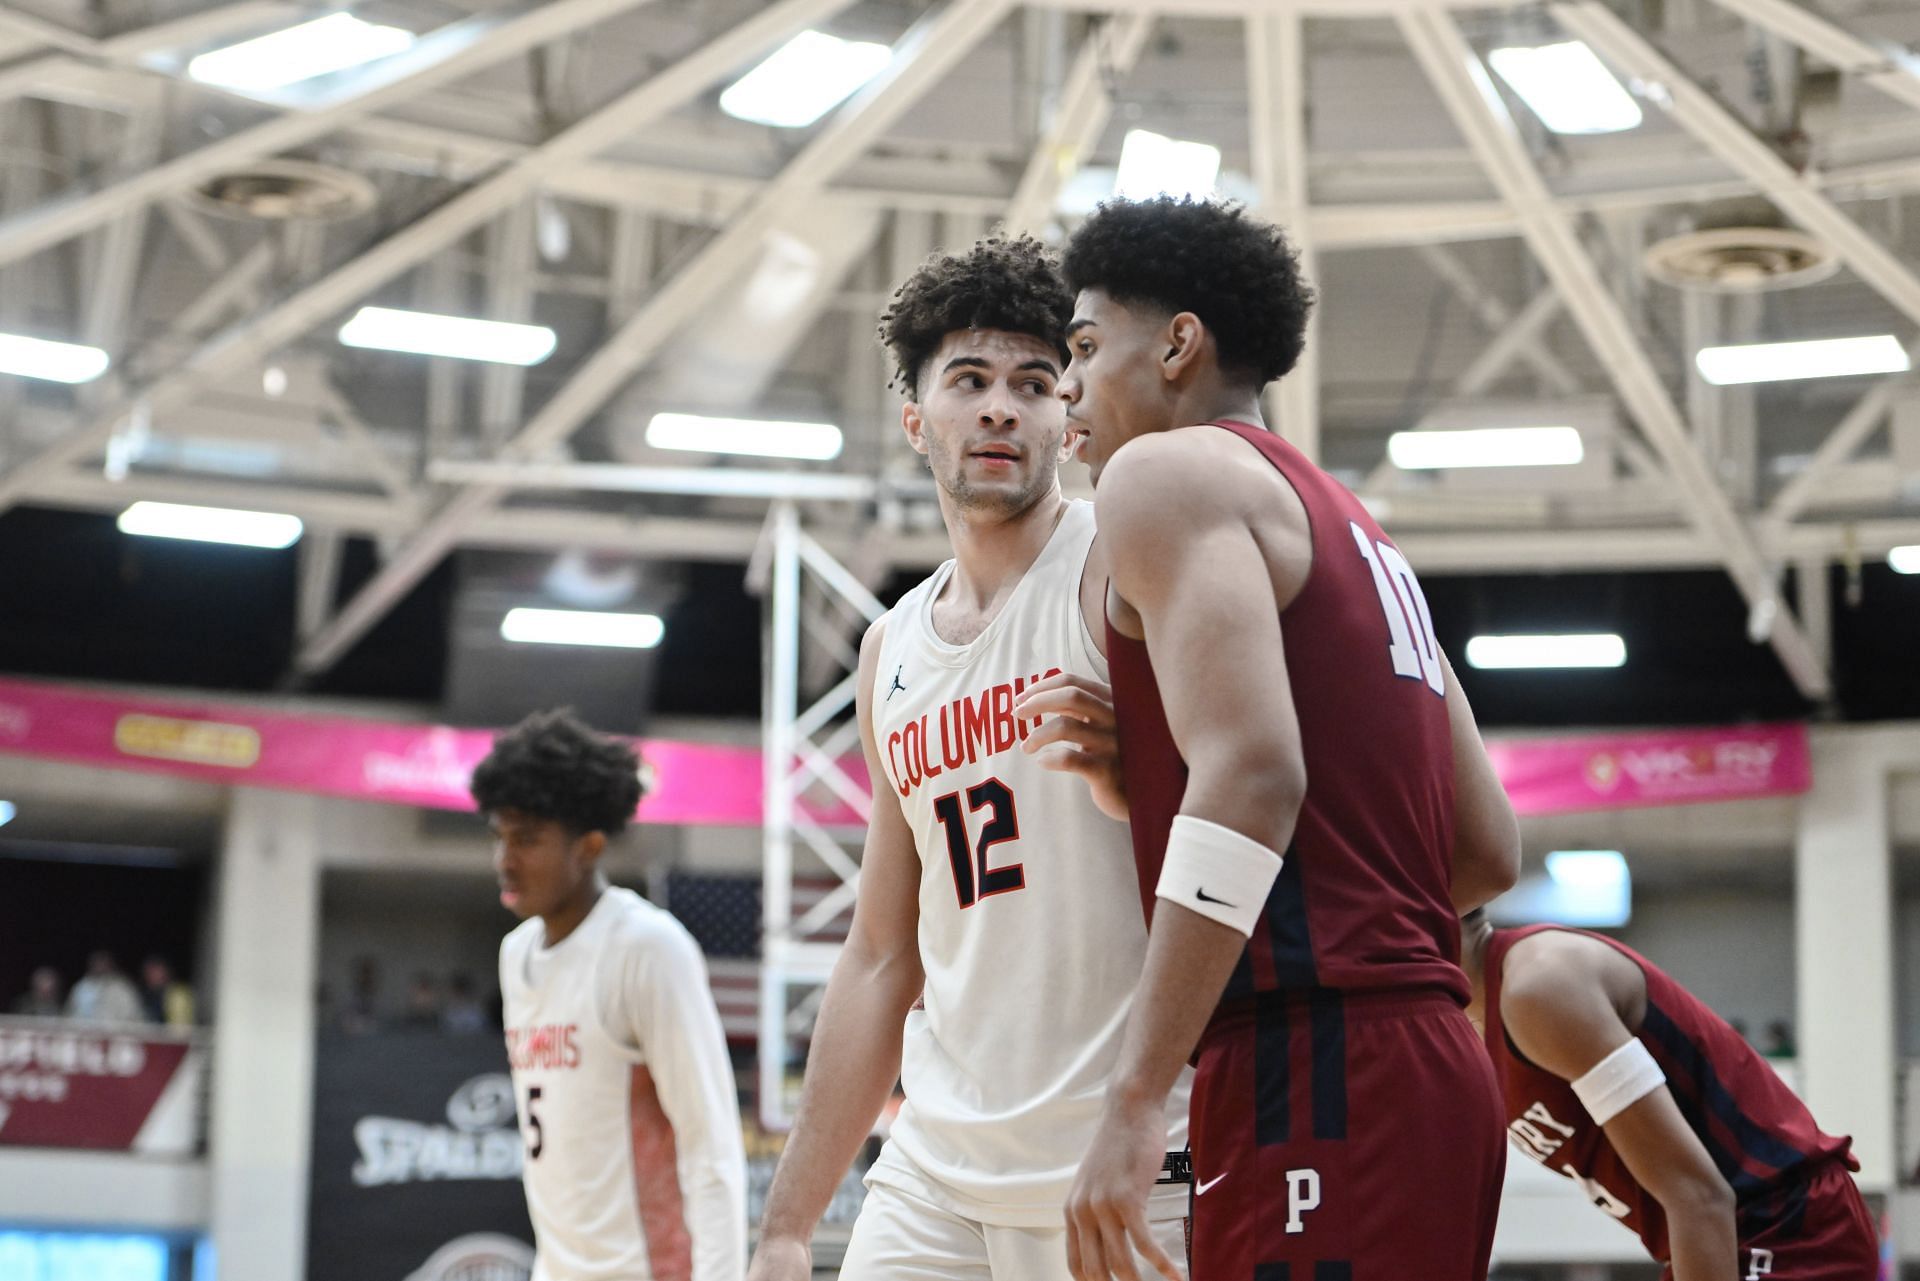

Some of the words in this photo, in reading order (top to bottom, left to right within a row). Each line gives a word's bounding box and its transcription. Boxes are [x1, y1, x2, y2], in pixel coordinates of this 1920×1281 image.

[1350, 521, 1445, 697] 10
[887, 667, 1065, 798] COLUMBU
[933, 776, 1026, 910] 12
[528, 1086, 543, 1160] 5
[1285, 1168, 1321, 1234] P
[1745, 1247, 1774, 1281] P
